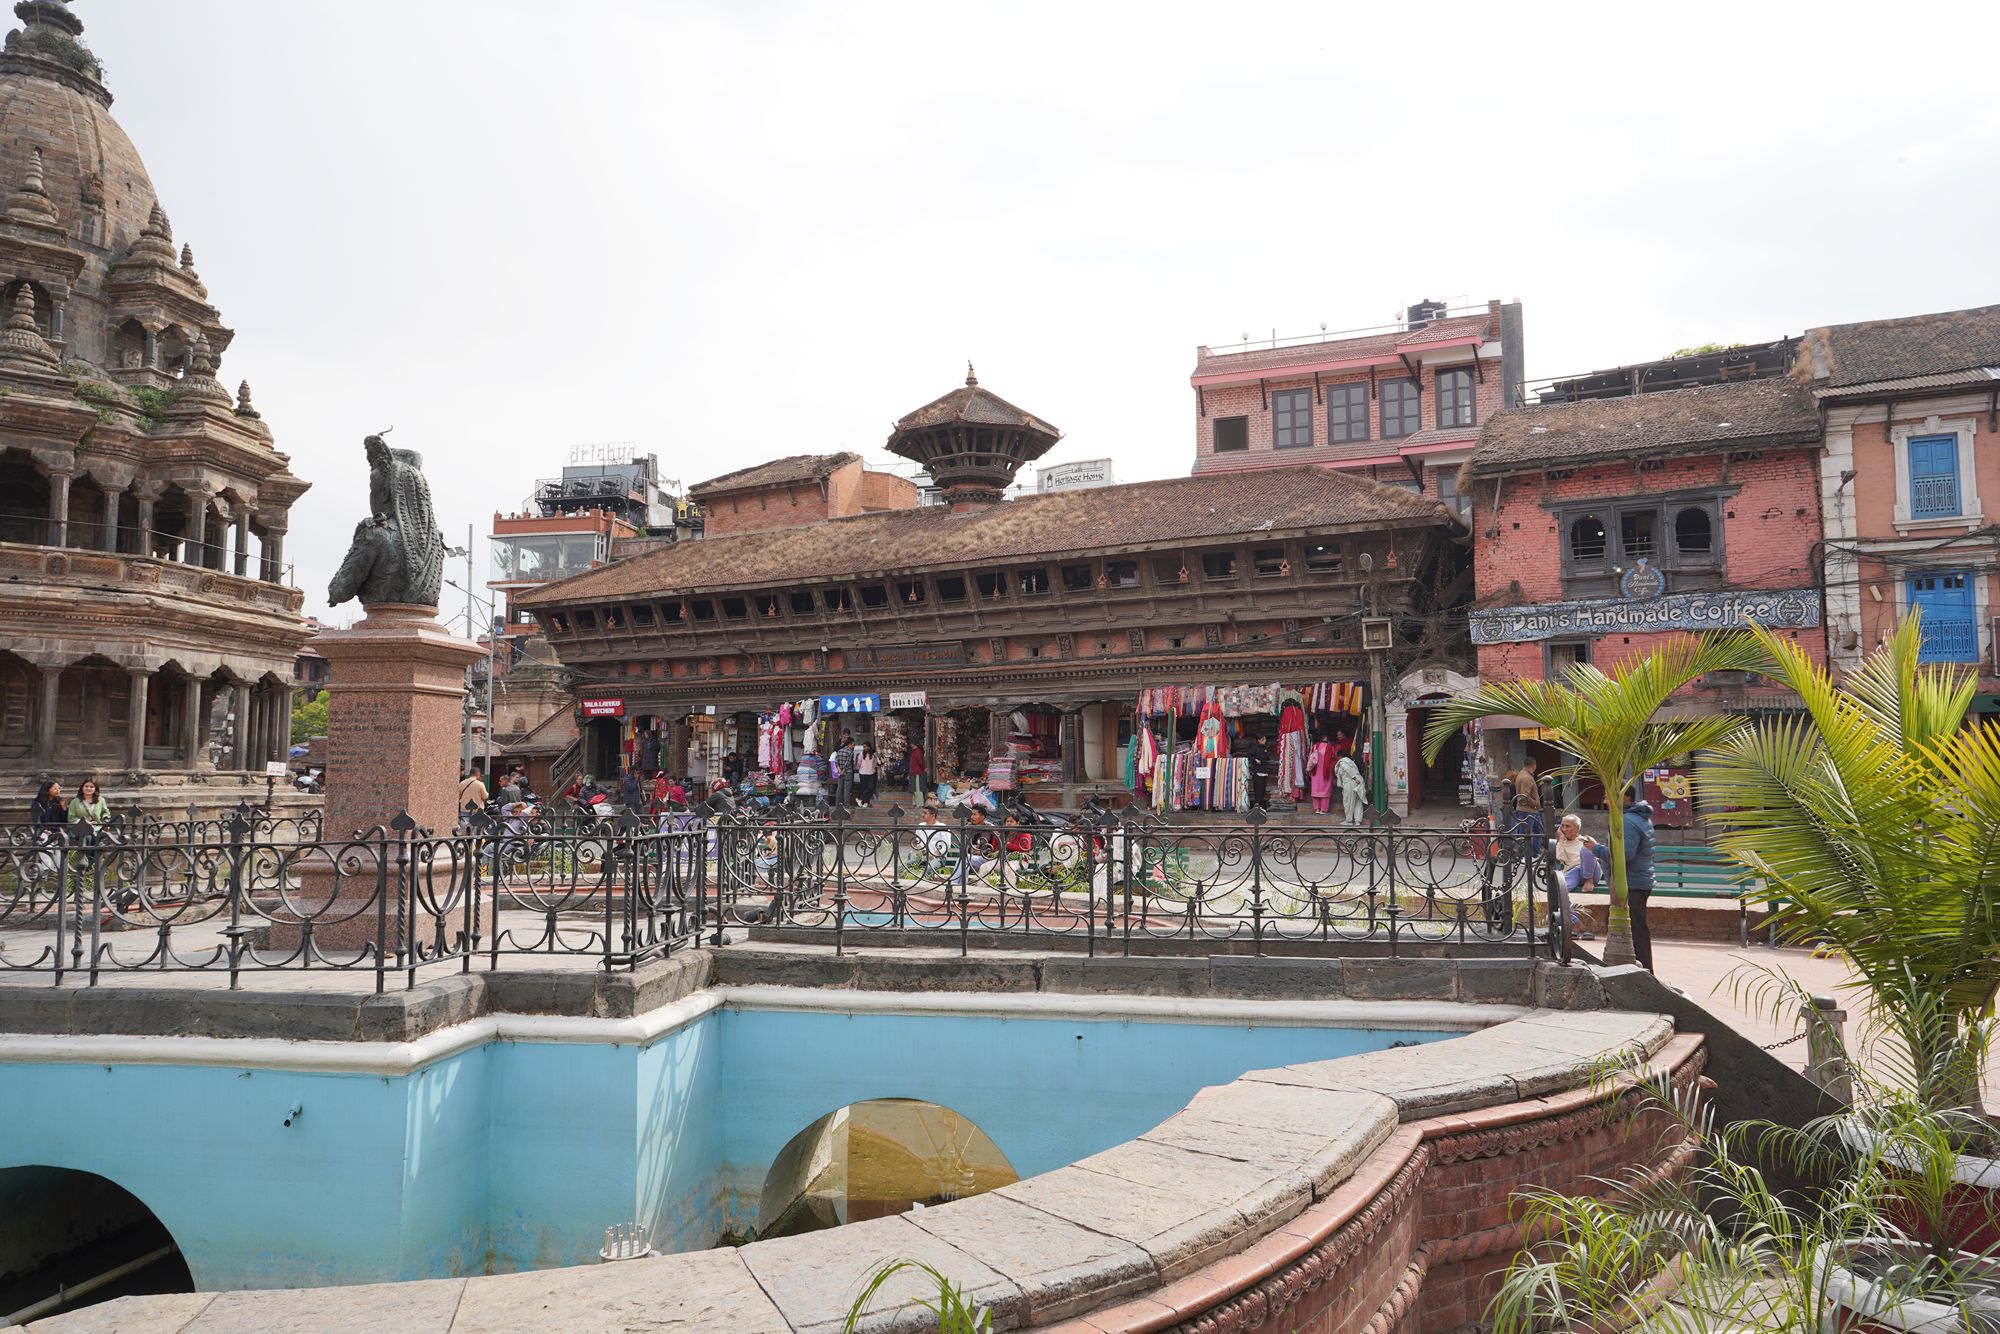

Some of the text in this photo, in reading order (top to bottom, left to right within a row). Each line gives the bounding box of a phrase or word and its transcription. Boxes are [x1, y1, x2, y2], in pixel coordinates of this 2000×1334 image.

[1055, 472, 1105, 486] Heritage Home
[1633, 573, 1655, 581] Dani's
[1511, 608, 1570, 632] Dani's
[1575, 601, 1682, 628] Handmade
[1689, 597, 1770, 626] Coffee
